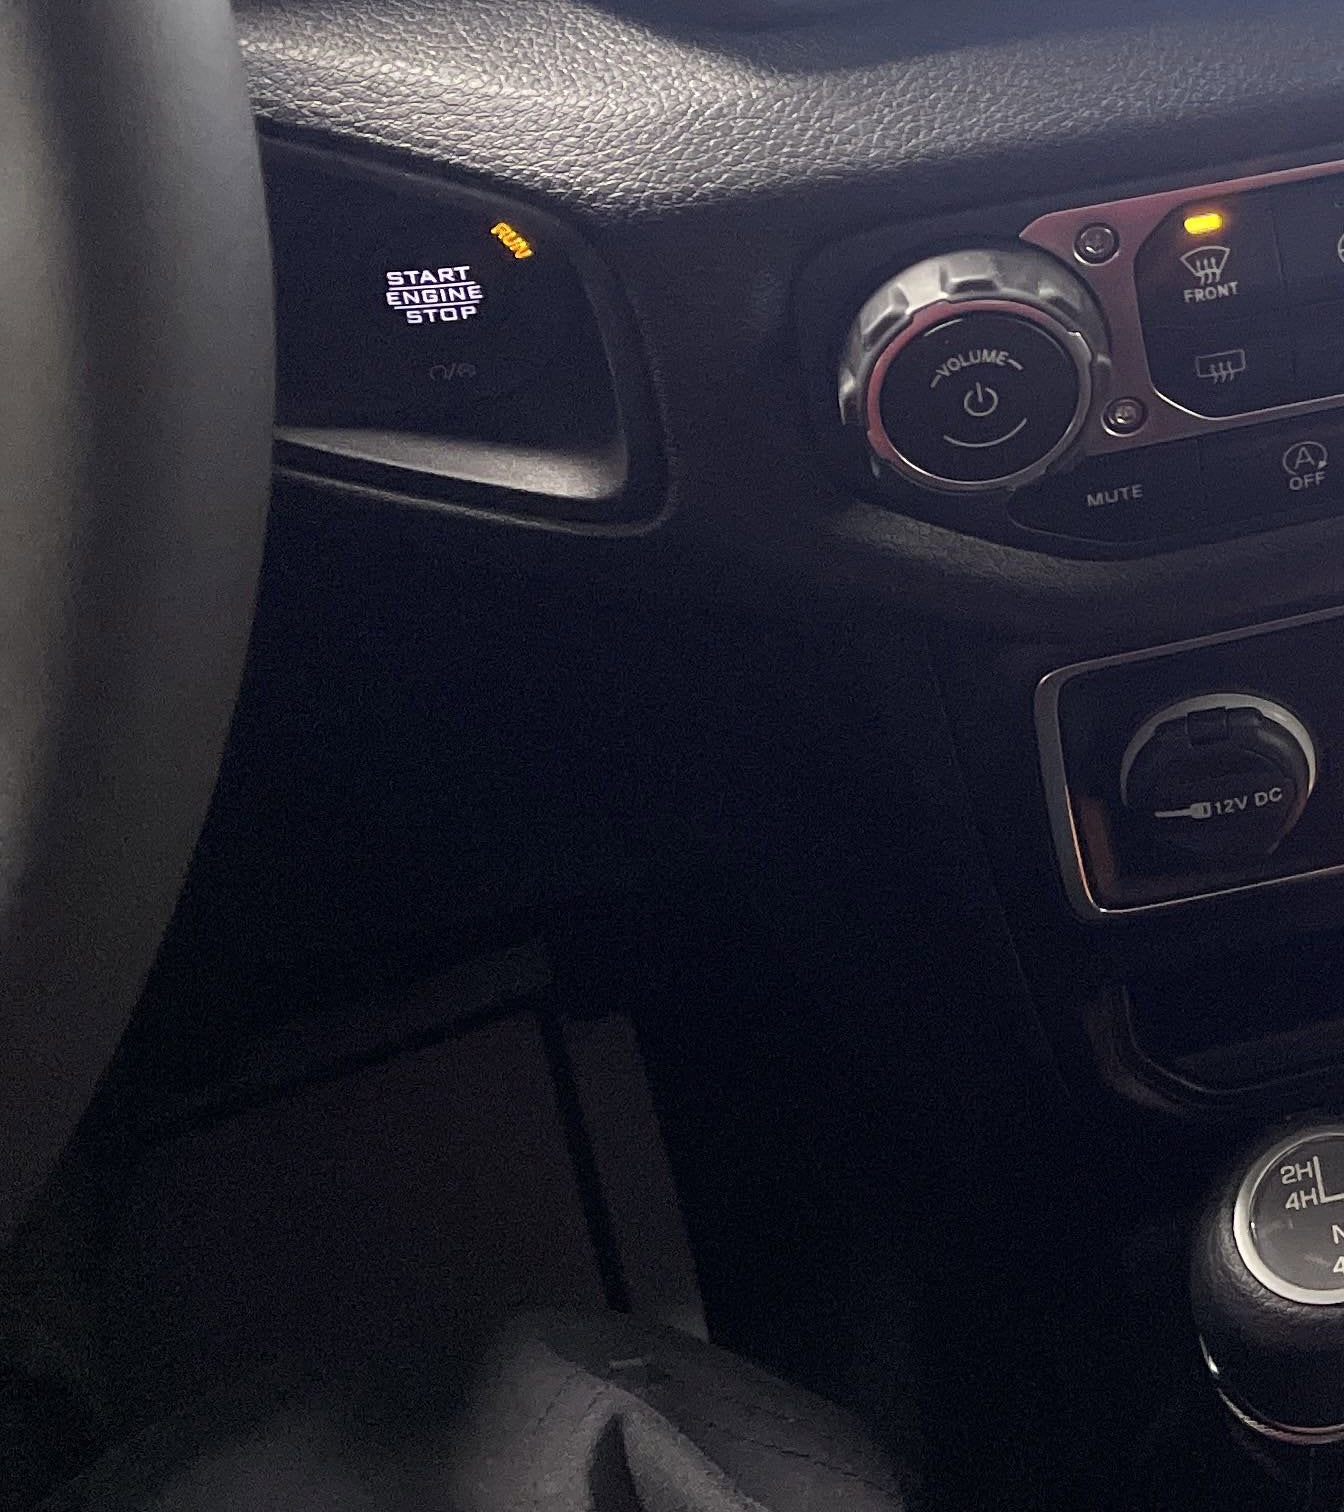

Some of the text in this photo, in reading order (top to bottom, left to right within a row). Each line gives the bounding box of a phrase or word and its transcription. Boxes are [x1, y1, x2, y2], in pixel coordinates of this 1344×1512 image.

[490, 222, 535, 260] RUN
[386, 265, 470, 286] START
[386, 284, 483, 306] ENGINE
[1183, 281, 1239, 304] FRONT
[406, 305, 478, 324] STOP
[936, 349, 1009, 377] VOLUME
[1289, 471, 1326, 491] OFF
[1086, 483, 1144, 507] MUTE
[1213, 786, 1283, 817] 12V DC
[1280, 1161, 1313, 1185] 2H
[1284, 1187, 1319, 1211] 4H
